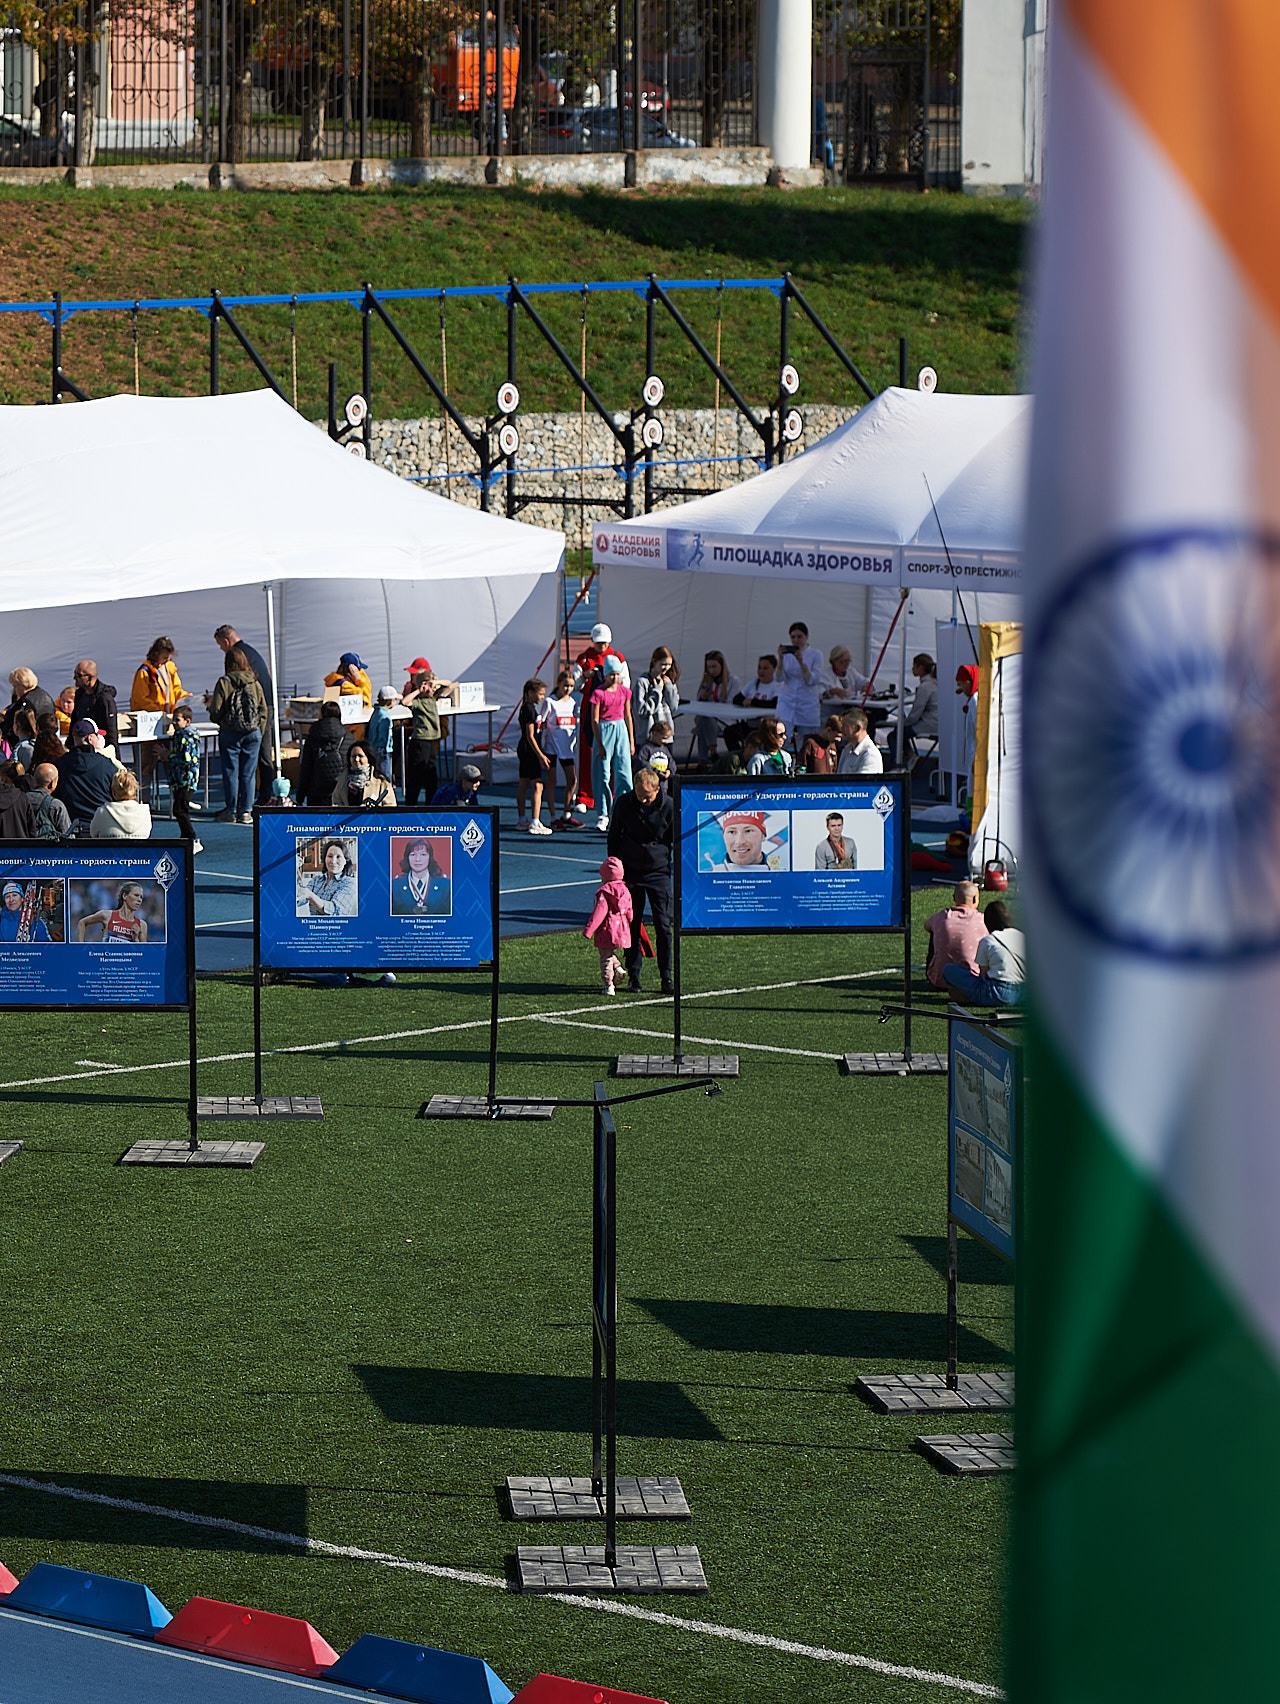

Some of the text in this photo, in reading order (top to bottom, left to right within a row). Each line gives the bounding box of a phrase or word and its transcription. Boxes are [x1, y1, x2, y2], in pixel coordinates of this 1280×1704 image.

[612, 533, 661, 547] АКАДЕМИЯ
[612, 545, 661, 558] ЗДОРОВЬЯ
[713, 545, 892, 573] ПЛОЩАДКА ЗДОРОВЬЯ
[756, 792, 796, 800] Удмуртии
[803, 792, 838, 800] гордость
[839, 792, 869, 800] страны
[339, 824, 381, 833] Удмуртии
[388, 824, 424, 833] гордость
[426, 824, 457, 833] страны
[29, 858, 73, 866] Удмуртии
[80, 858, 117, 866] гордость
[119, 858, 150, 866] страны
